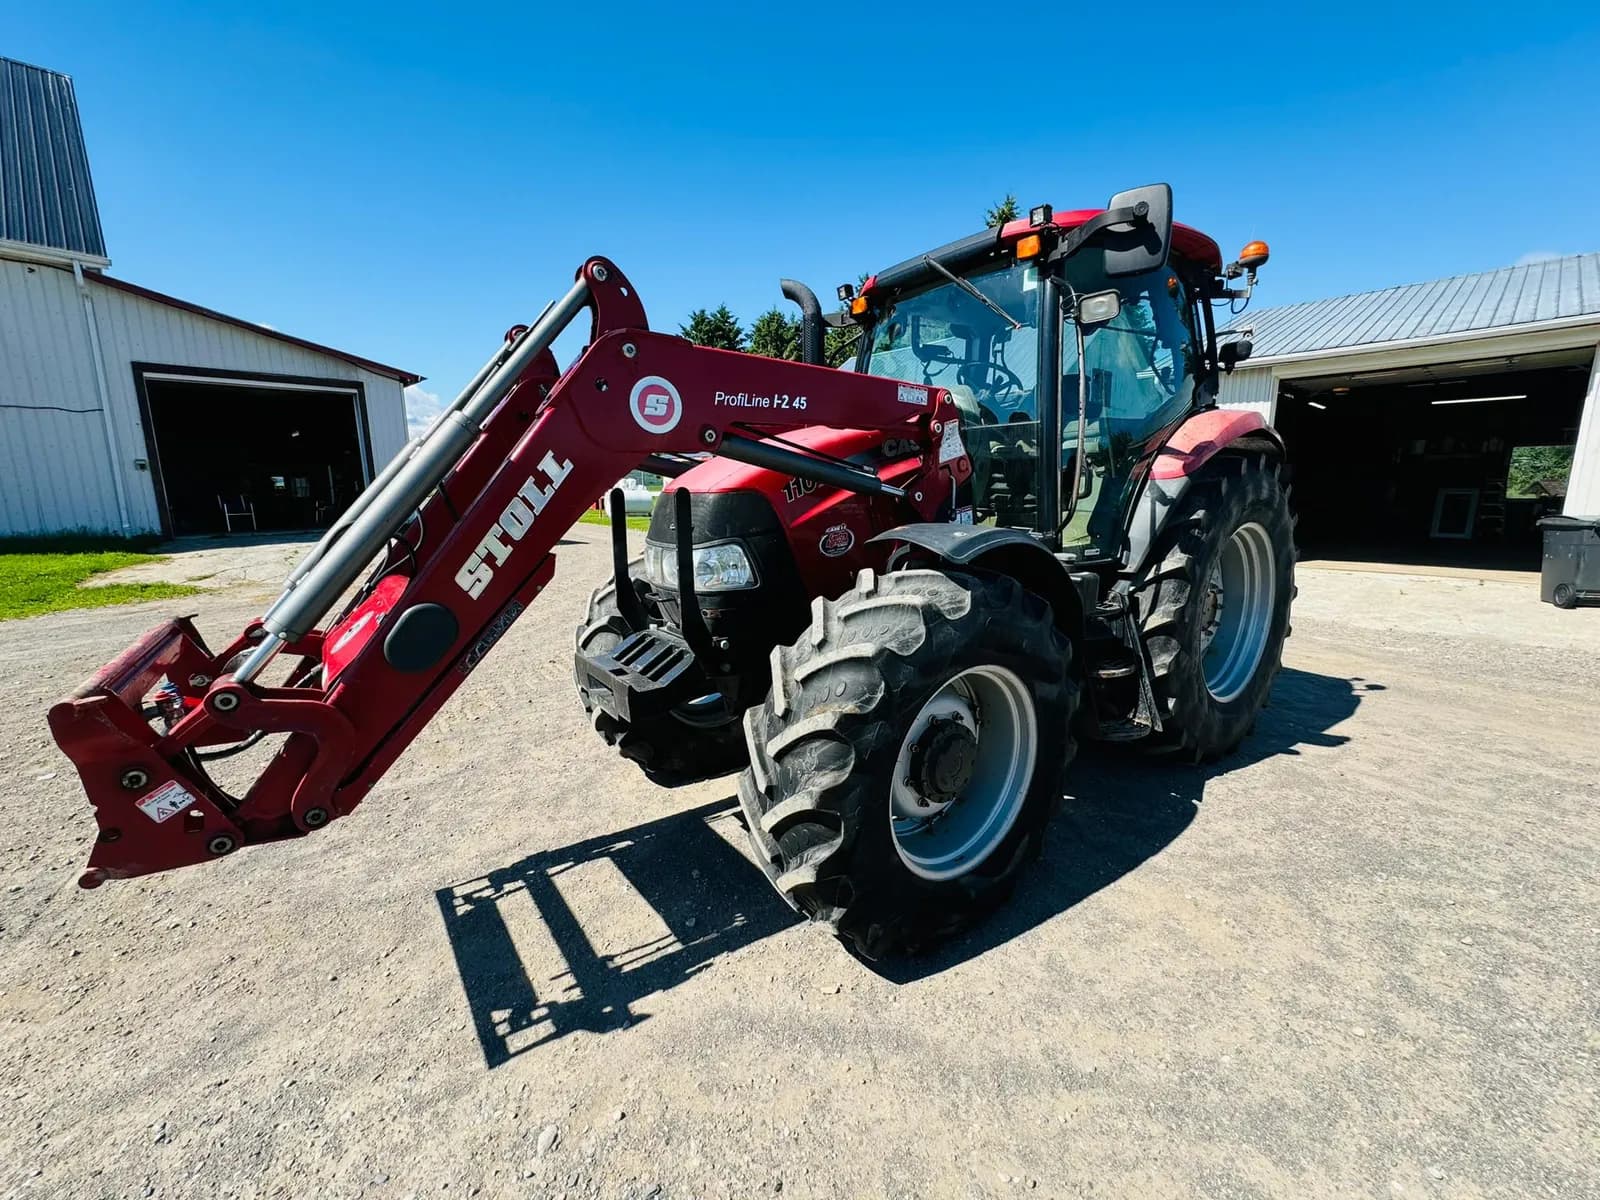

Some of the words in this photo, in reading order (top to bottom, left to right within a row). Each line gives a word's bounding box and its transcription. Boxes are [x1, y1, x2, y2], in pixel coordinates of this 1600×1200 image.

[714, 391, 770, 408] ProfiLine
[792, 396, 807, 410] 45
[883, 438, 921, 457] CAS
[780, 475, 825, 503] 110
[454, 449, 575, 601] STOLL
